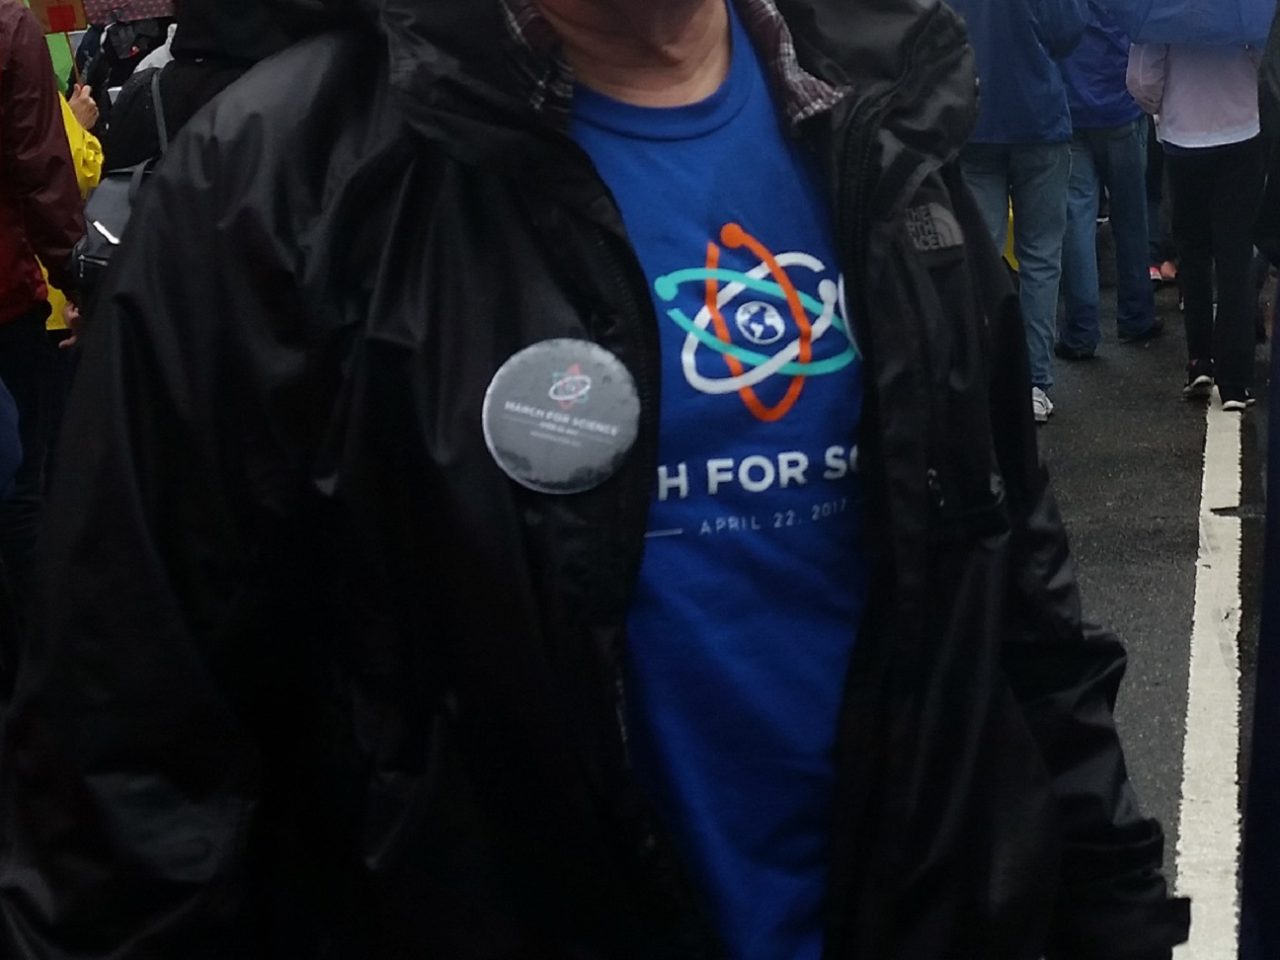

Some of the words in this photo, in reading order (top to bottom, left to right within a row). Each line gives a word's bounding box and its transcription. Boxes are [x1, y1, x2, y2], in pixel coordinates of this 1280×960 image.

[546, 411, 570, 424] FOR
[707, 451, 809, 495] FOR
[699, 515, 761, 536] APRIL
